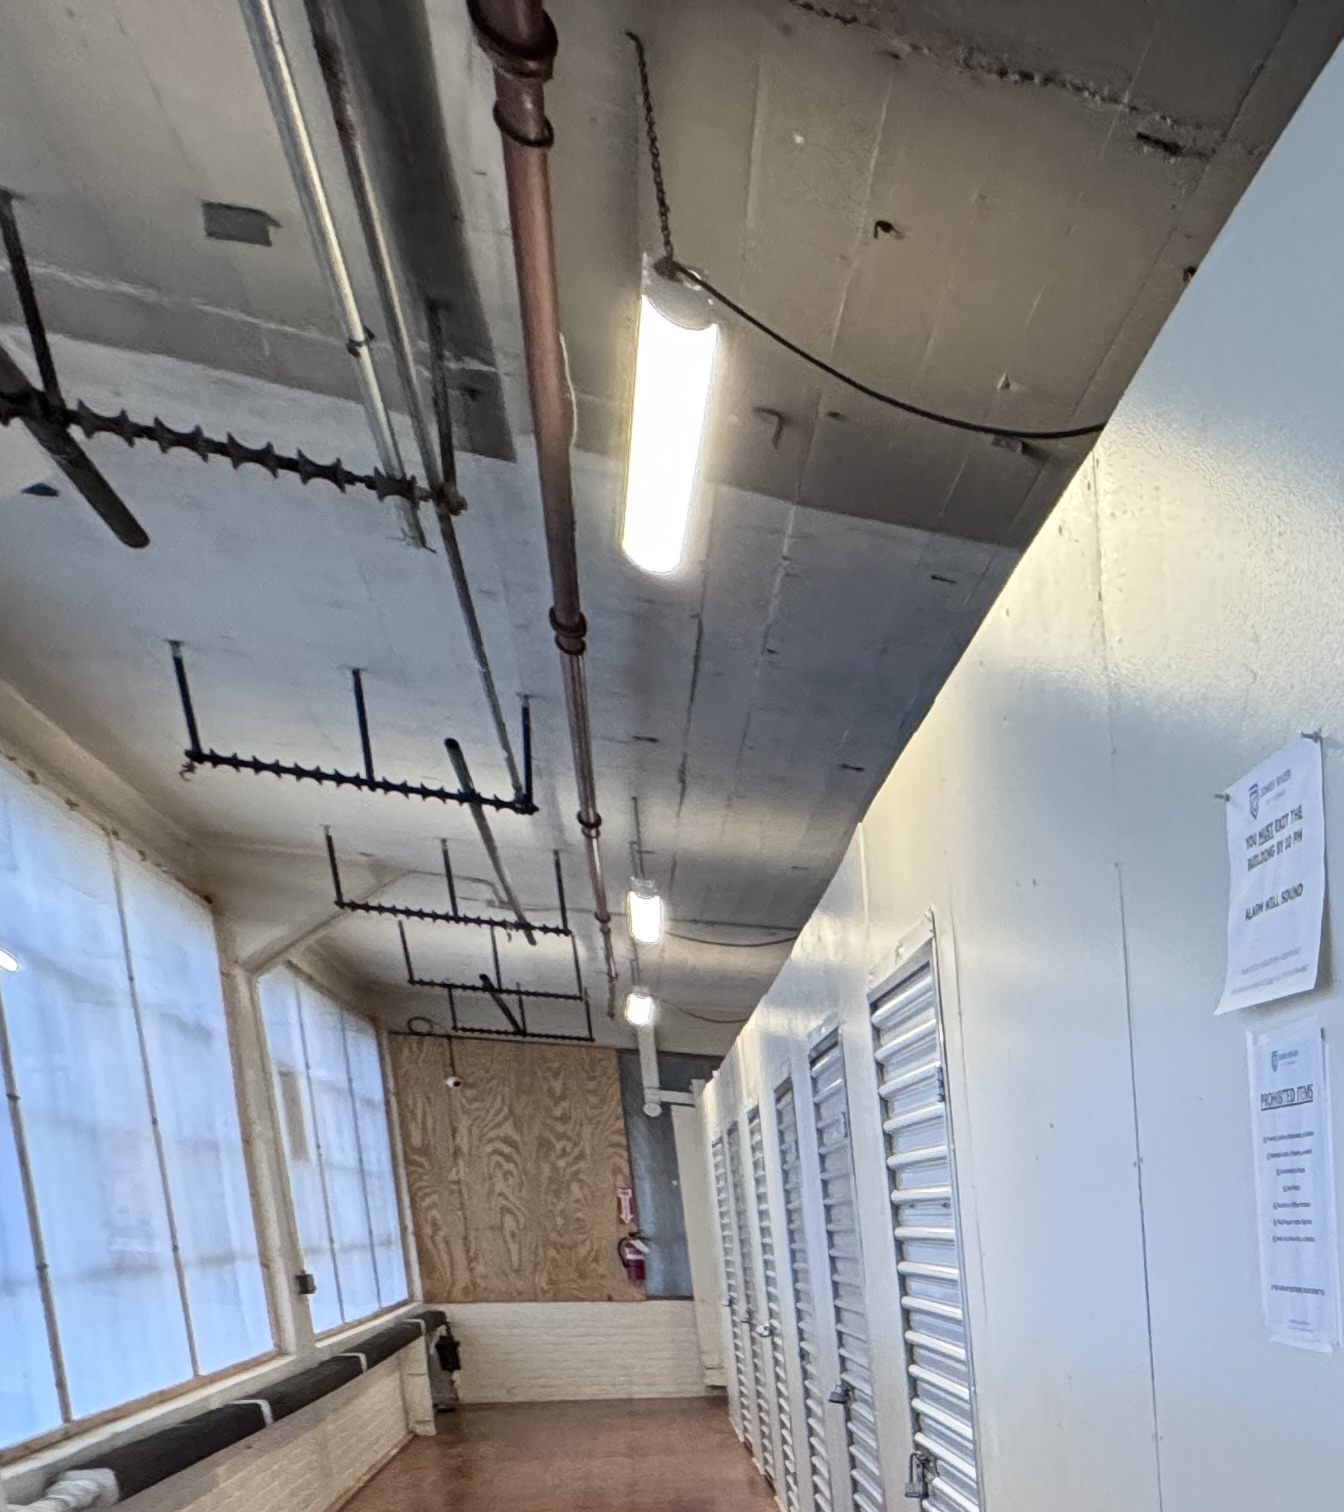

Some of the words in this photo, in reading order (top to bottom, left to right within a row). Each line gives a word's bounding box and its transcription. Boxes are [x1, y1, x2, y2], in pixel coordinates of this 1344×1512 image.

[1258, 822, 1275, 846] MUST
[1274, 812, 1289, 834] EXIT
[1290, 804, 1303, 824] THE
[1247, 843, 1275, 872] BUILDING
[1276, 839, 1284, 855] BY
[1293, 828, 1303, 845] PM
[1245, 900, 1263, 921] ALARM
[1265, 894, 1279, 912] WILL
[1280, 882, 1304, 905] SOUND
[1260, 1087, 1296, 1110] PROHIBITED
[1296, 1082, 1314, 1102] ITEMS
